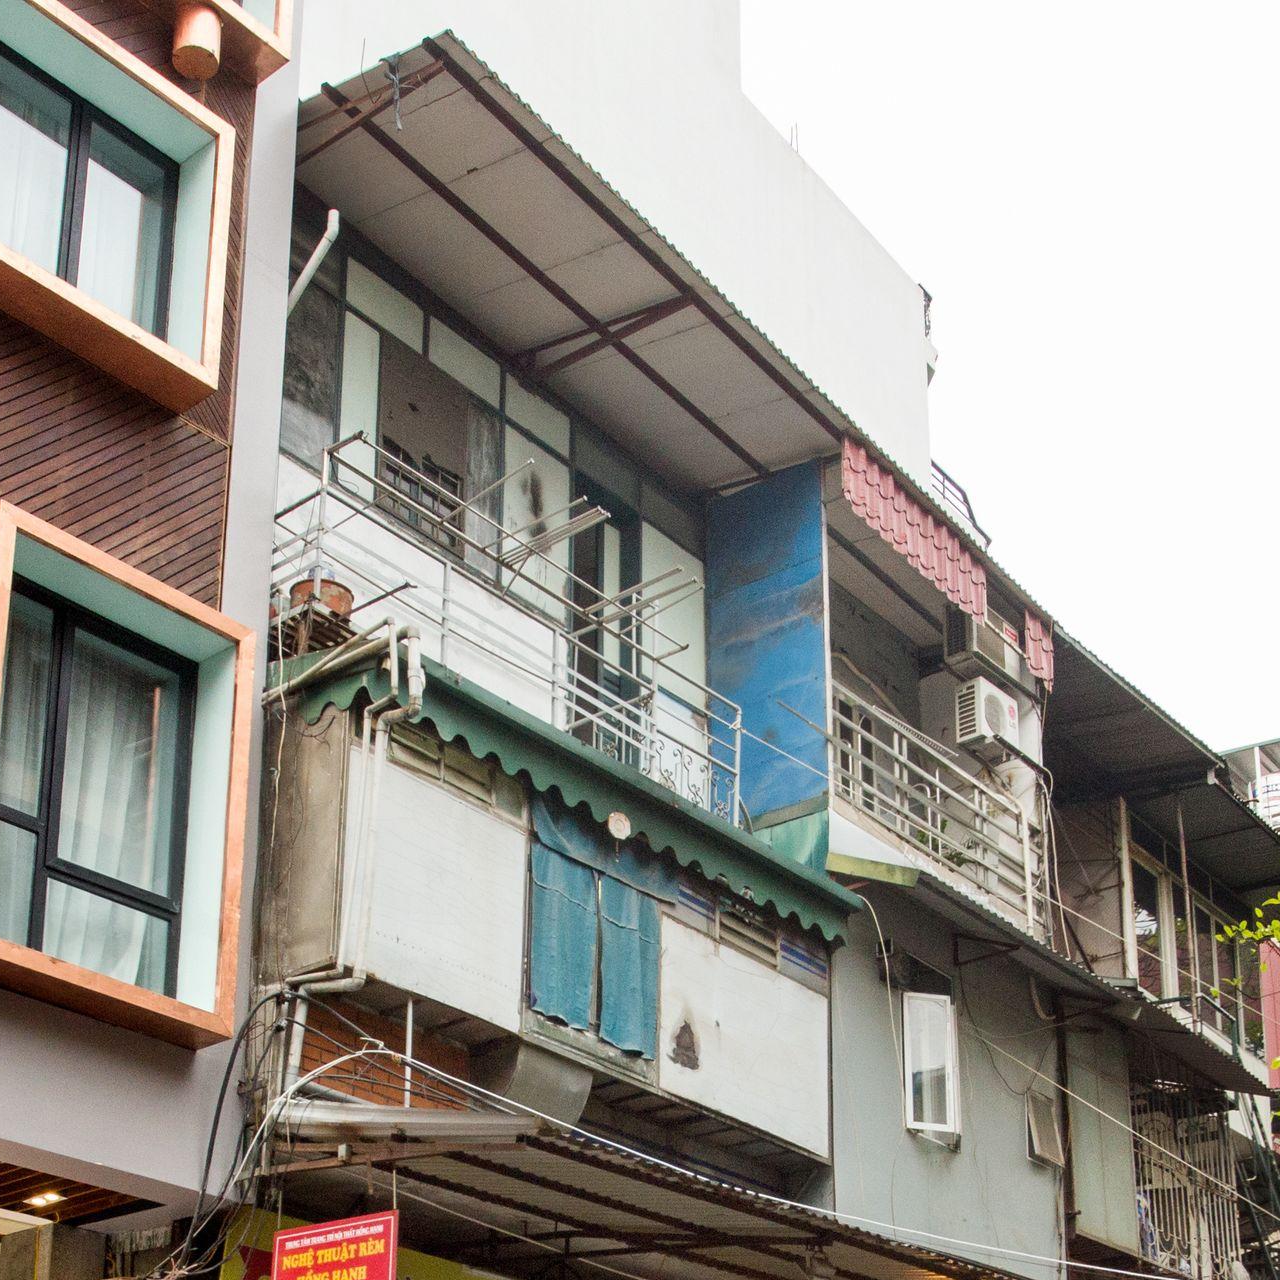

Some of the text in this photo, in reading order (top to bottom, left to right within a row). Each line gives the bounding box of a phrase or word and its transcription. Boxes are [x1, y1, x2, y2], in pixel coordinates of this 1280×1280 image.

[282, 1237, 385, 1270] NGHỆ THUẬT RÈM
